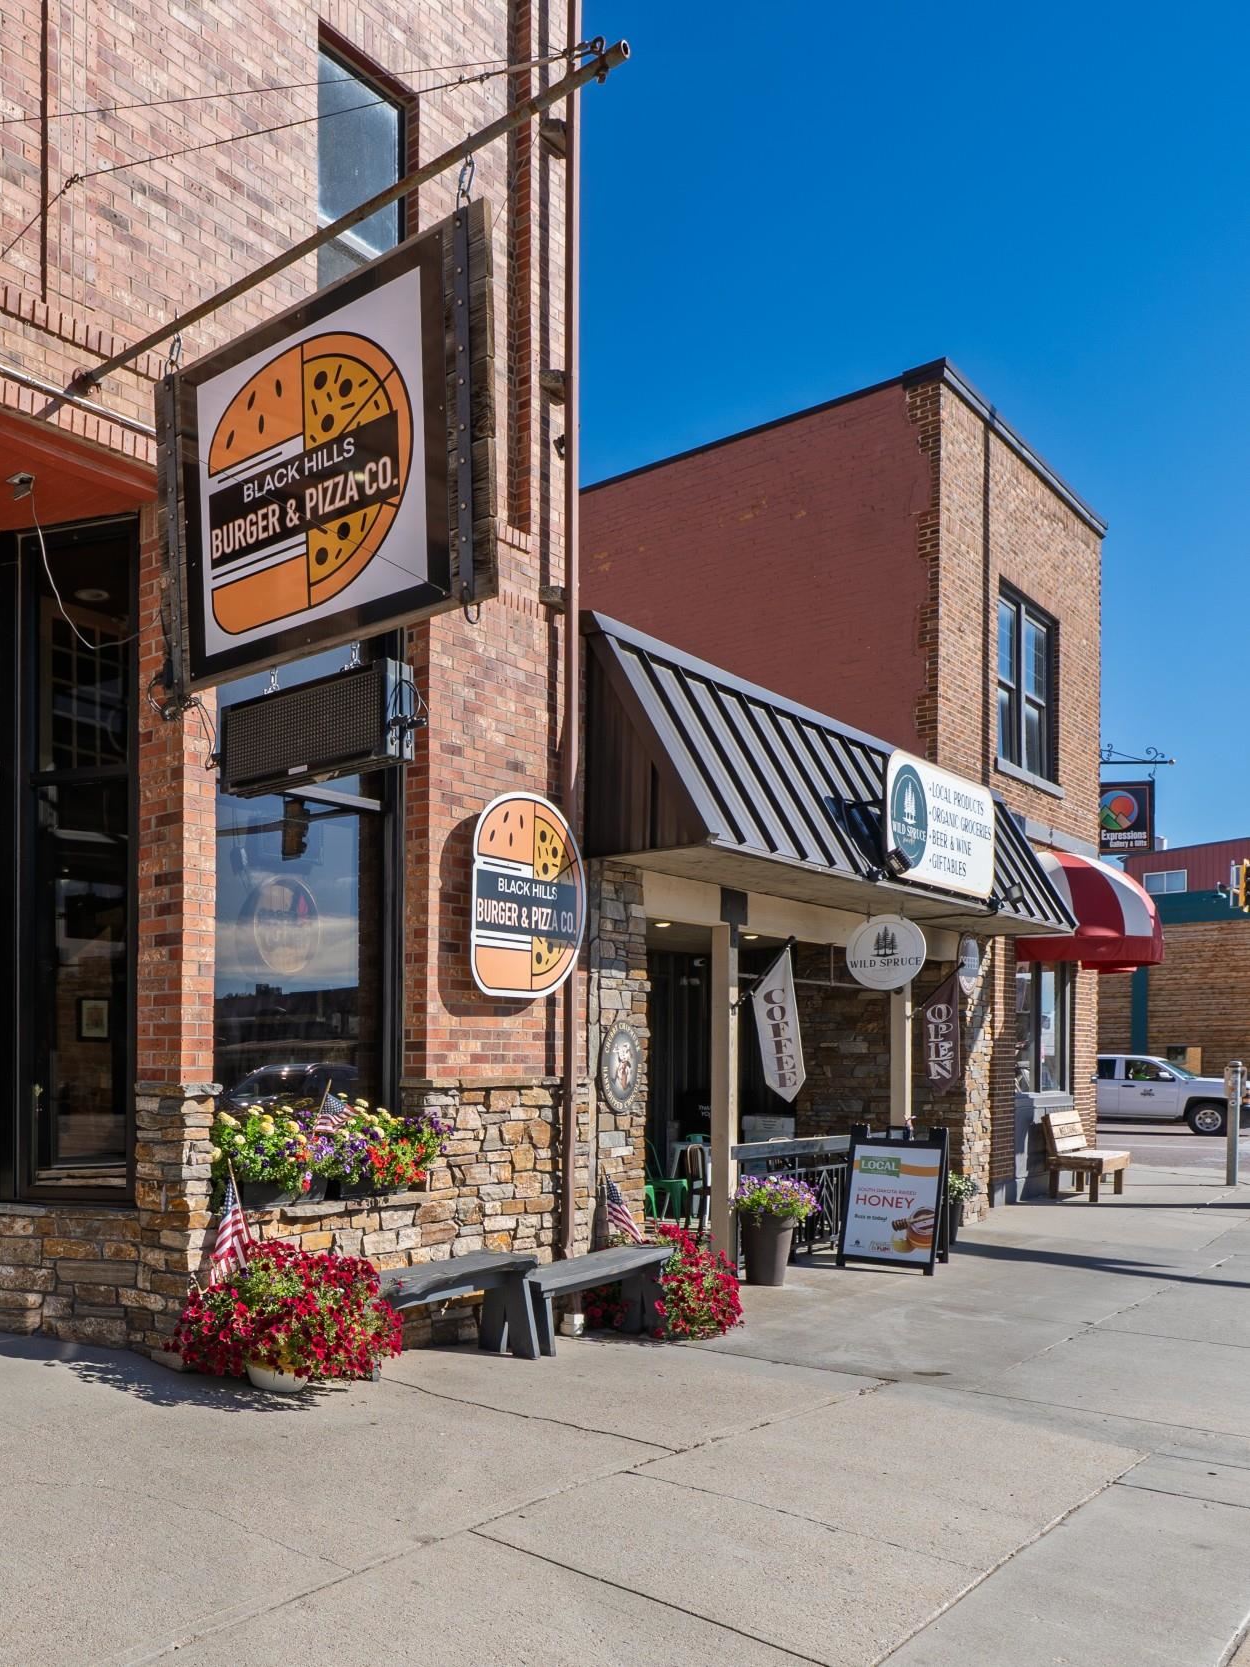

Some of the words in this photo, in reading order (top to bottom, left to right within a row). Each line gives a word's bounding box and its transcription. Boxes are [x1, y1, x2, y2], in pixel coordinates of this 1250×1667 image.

[243, 461, 300, 503] BLACK
[304, 437, 355, 475] HILLS
[211, 503, 280, 560] BURGER
[286, 498, 300, 528] &
[305, 471, 359, 520] PIZZA
[364, 456, 399, 495] CO.
[931, 781, 951, 804] LOCAL
[953, 791, 984, 816] PRODUCTS
[892, 820, 906, 834] WILD
[906, 826, 927, 842] SPRUCE
[931, 806, 959, 829] ORGANIC
[960, 816, 992, 840] GROCERIES
[1101, 830, 1147, 841] Expressions
[931, 829, 948, 848] BEER
[950, 836, 955, 850] &
[956, 838, 972, 856] WINE
[931, 853, 967, 877] GIFTABLES
[498, 878, 530, 896] BLACK
[532, 883, 558, 900] HILLS
[477, 898, 518, 927] BURGER
[521, 907, 529, 928] &
[531, 906, 558, 931] PIZZA
[560, 911, 576, 934] CO.
[850, 959, 876, 968] WILD
[879, 956, 922, 967] SPRUCE
[605, 1023, 618, 1053] CHUBBY
[763, 988, 797, 1089] COFFEE
[926, 1003, 953, 1080] OPEN
[861, 1160, 899, 1171] LOCAL
[855, 1193, 915, 1209] HONEY
